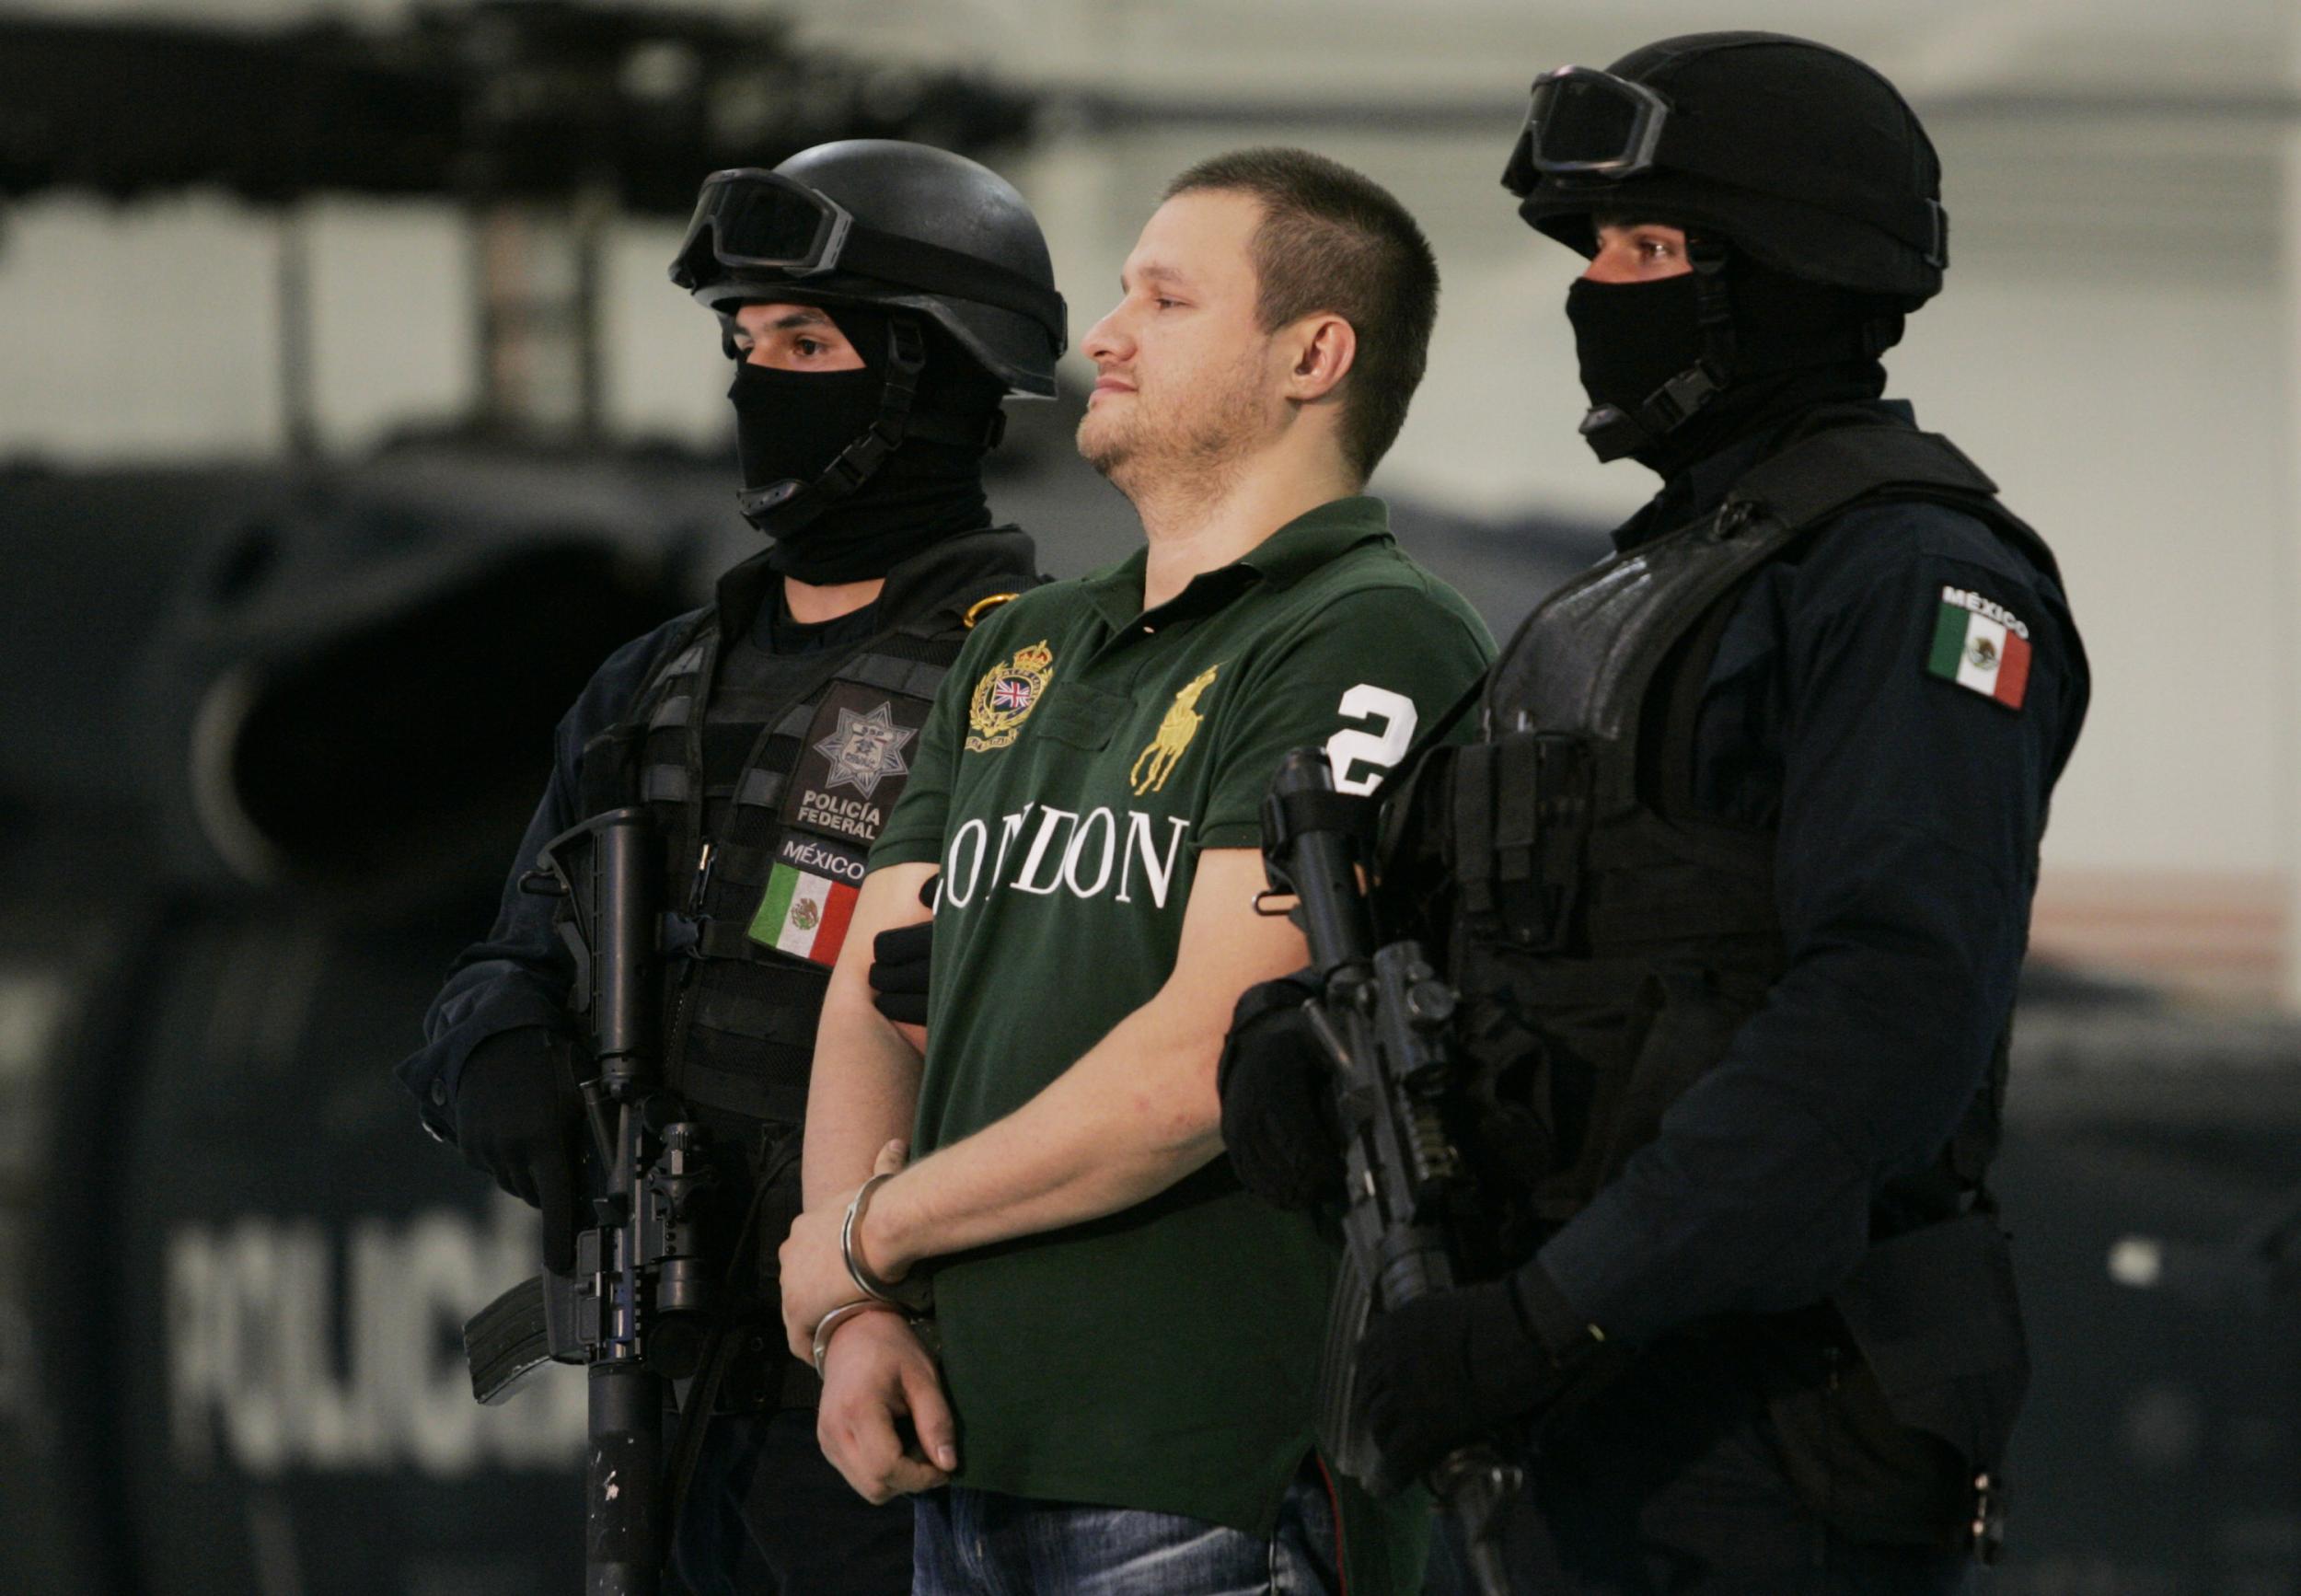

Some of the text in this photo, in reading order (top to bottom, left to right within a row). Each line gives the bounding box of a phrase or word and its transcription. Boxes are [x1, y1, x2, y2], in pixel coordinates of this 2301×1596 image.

[1326, 683, 1417, 797] 2
[797, 806, 875, 839] FEDERAL
[803, 790, 880, 826] POLICÍA
[783, 840, 865, 880] MÉXICO
